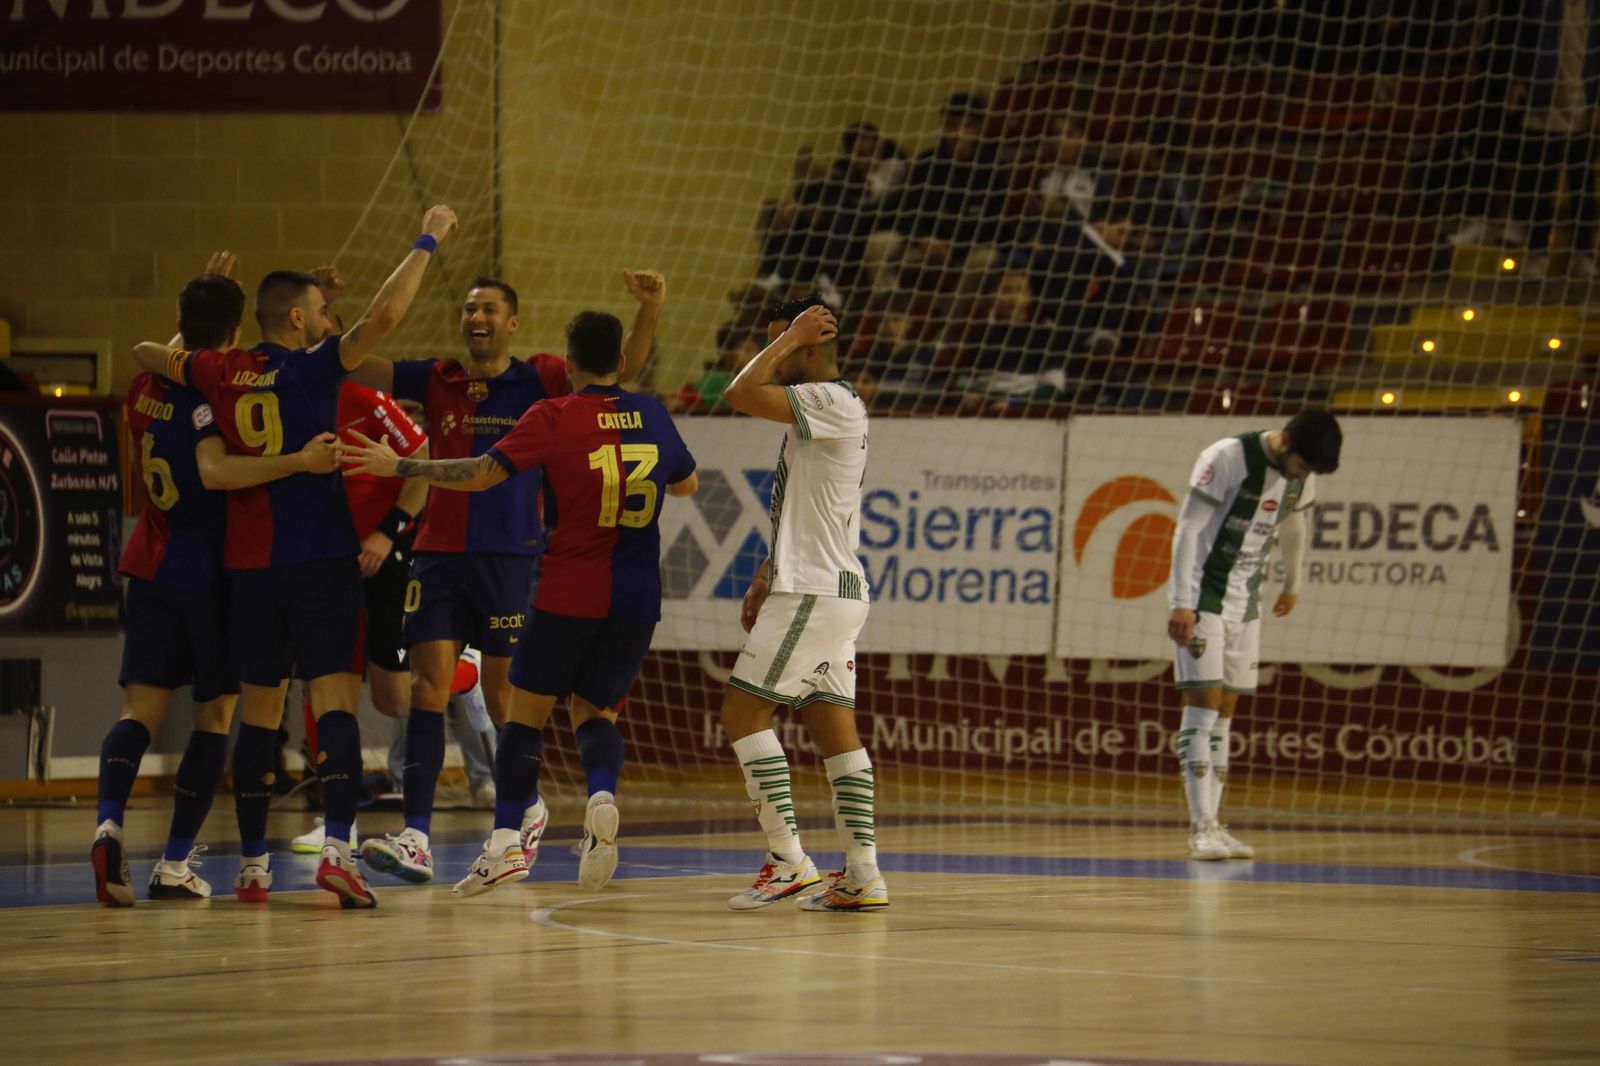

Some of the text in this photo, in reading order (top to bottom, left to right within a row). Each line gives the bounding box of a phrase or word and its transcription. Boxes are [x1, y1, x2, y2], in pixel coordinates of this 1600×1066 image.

[113, 45, 148, 73] de
[158, 44, 286, 78] Deportes
[293, 44, 413, 74] Córdoba
[235, 390, 284, 457] 9
[597, 411, 643, 430] CATELA
[52, 448, 108, 465] Calle Pintor
[140, 430, 181, 512] 6
[588, 443, 659, 529] 13
[921, 470, 1056, 494] Transportes
[859, 488, 1054, 552] Sierra
[82, 553, 103, 567] Vista
[857, 554, 1051, 604] Morena
[870, 714, 1061, 761] Municipal
[1074, 719, 1125, 756] de
[1336, 720, 1518, 764] Córdoba
